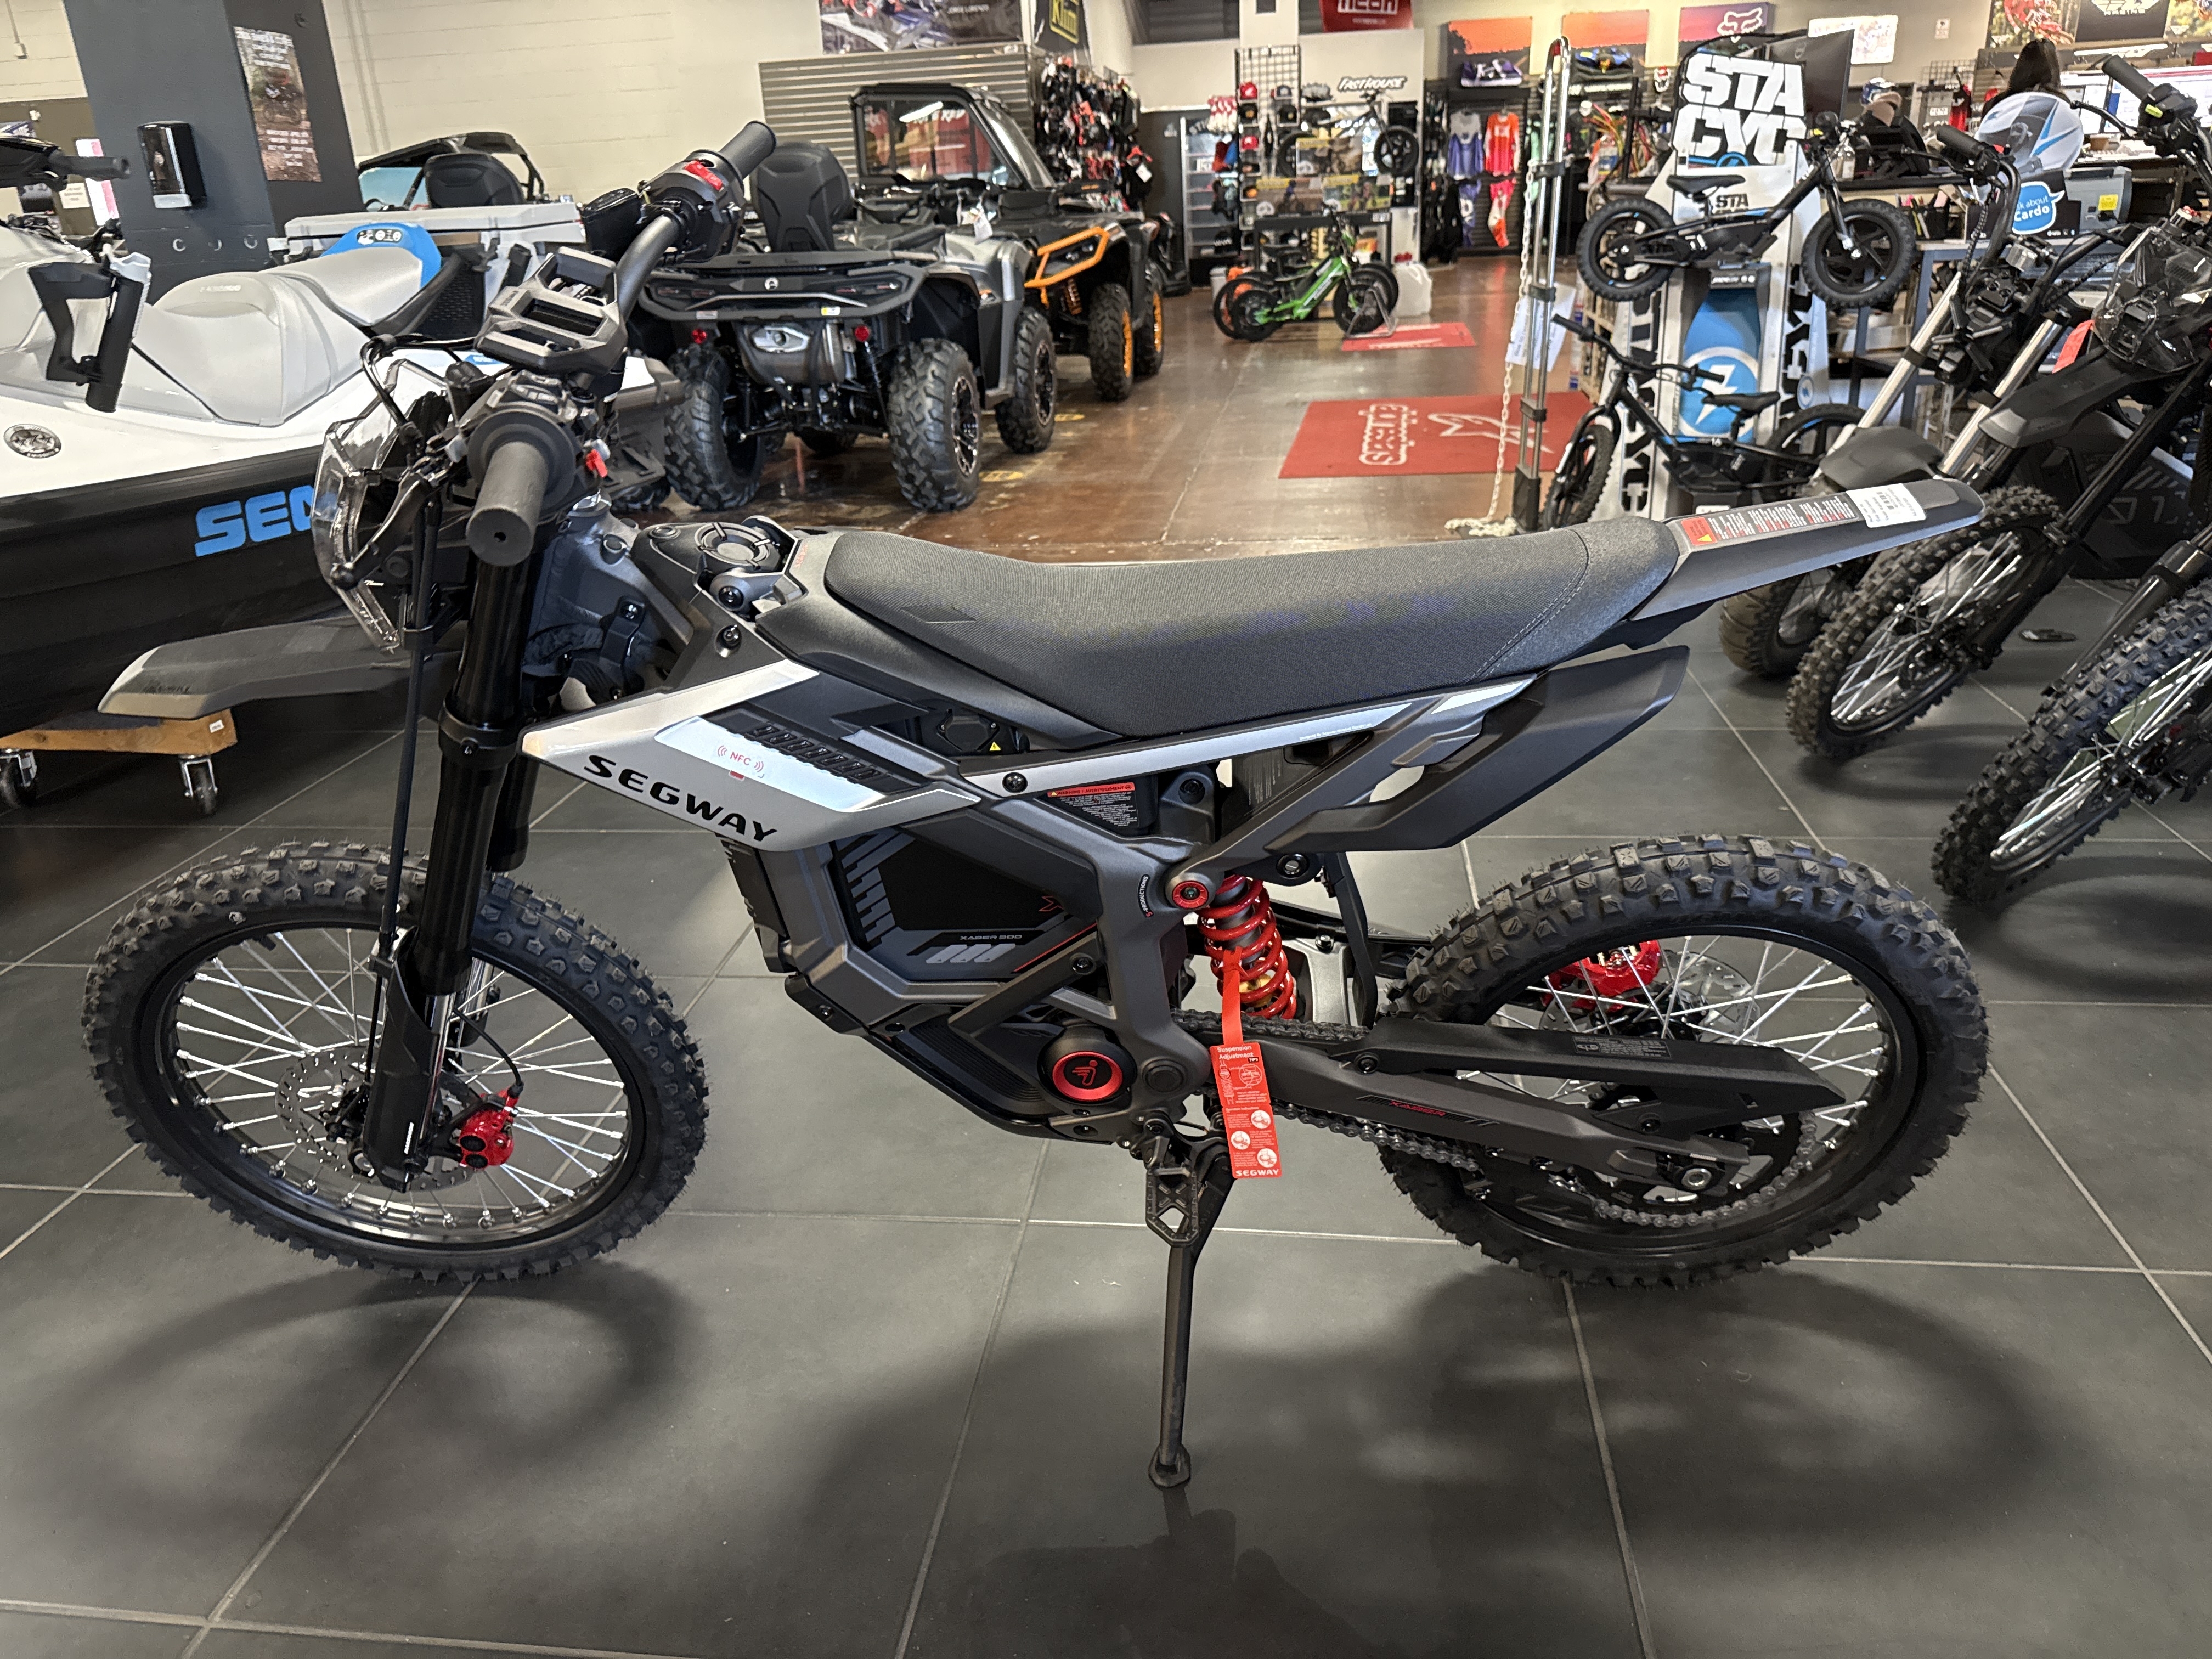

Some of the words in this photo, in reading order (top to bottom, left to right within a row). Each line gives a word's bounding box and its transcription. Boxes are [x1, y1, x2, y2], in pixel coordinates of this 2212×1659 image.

[2014, 205, 2050, 222] Cardo
[730, 751, 752, 768] NFC
[584, 755, 778, 842] SEGWAY
[1139, 876, 1153, 917] S-PRODUCTIONS
